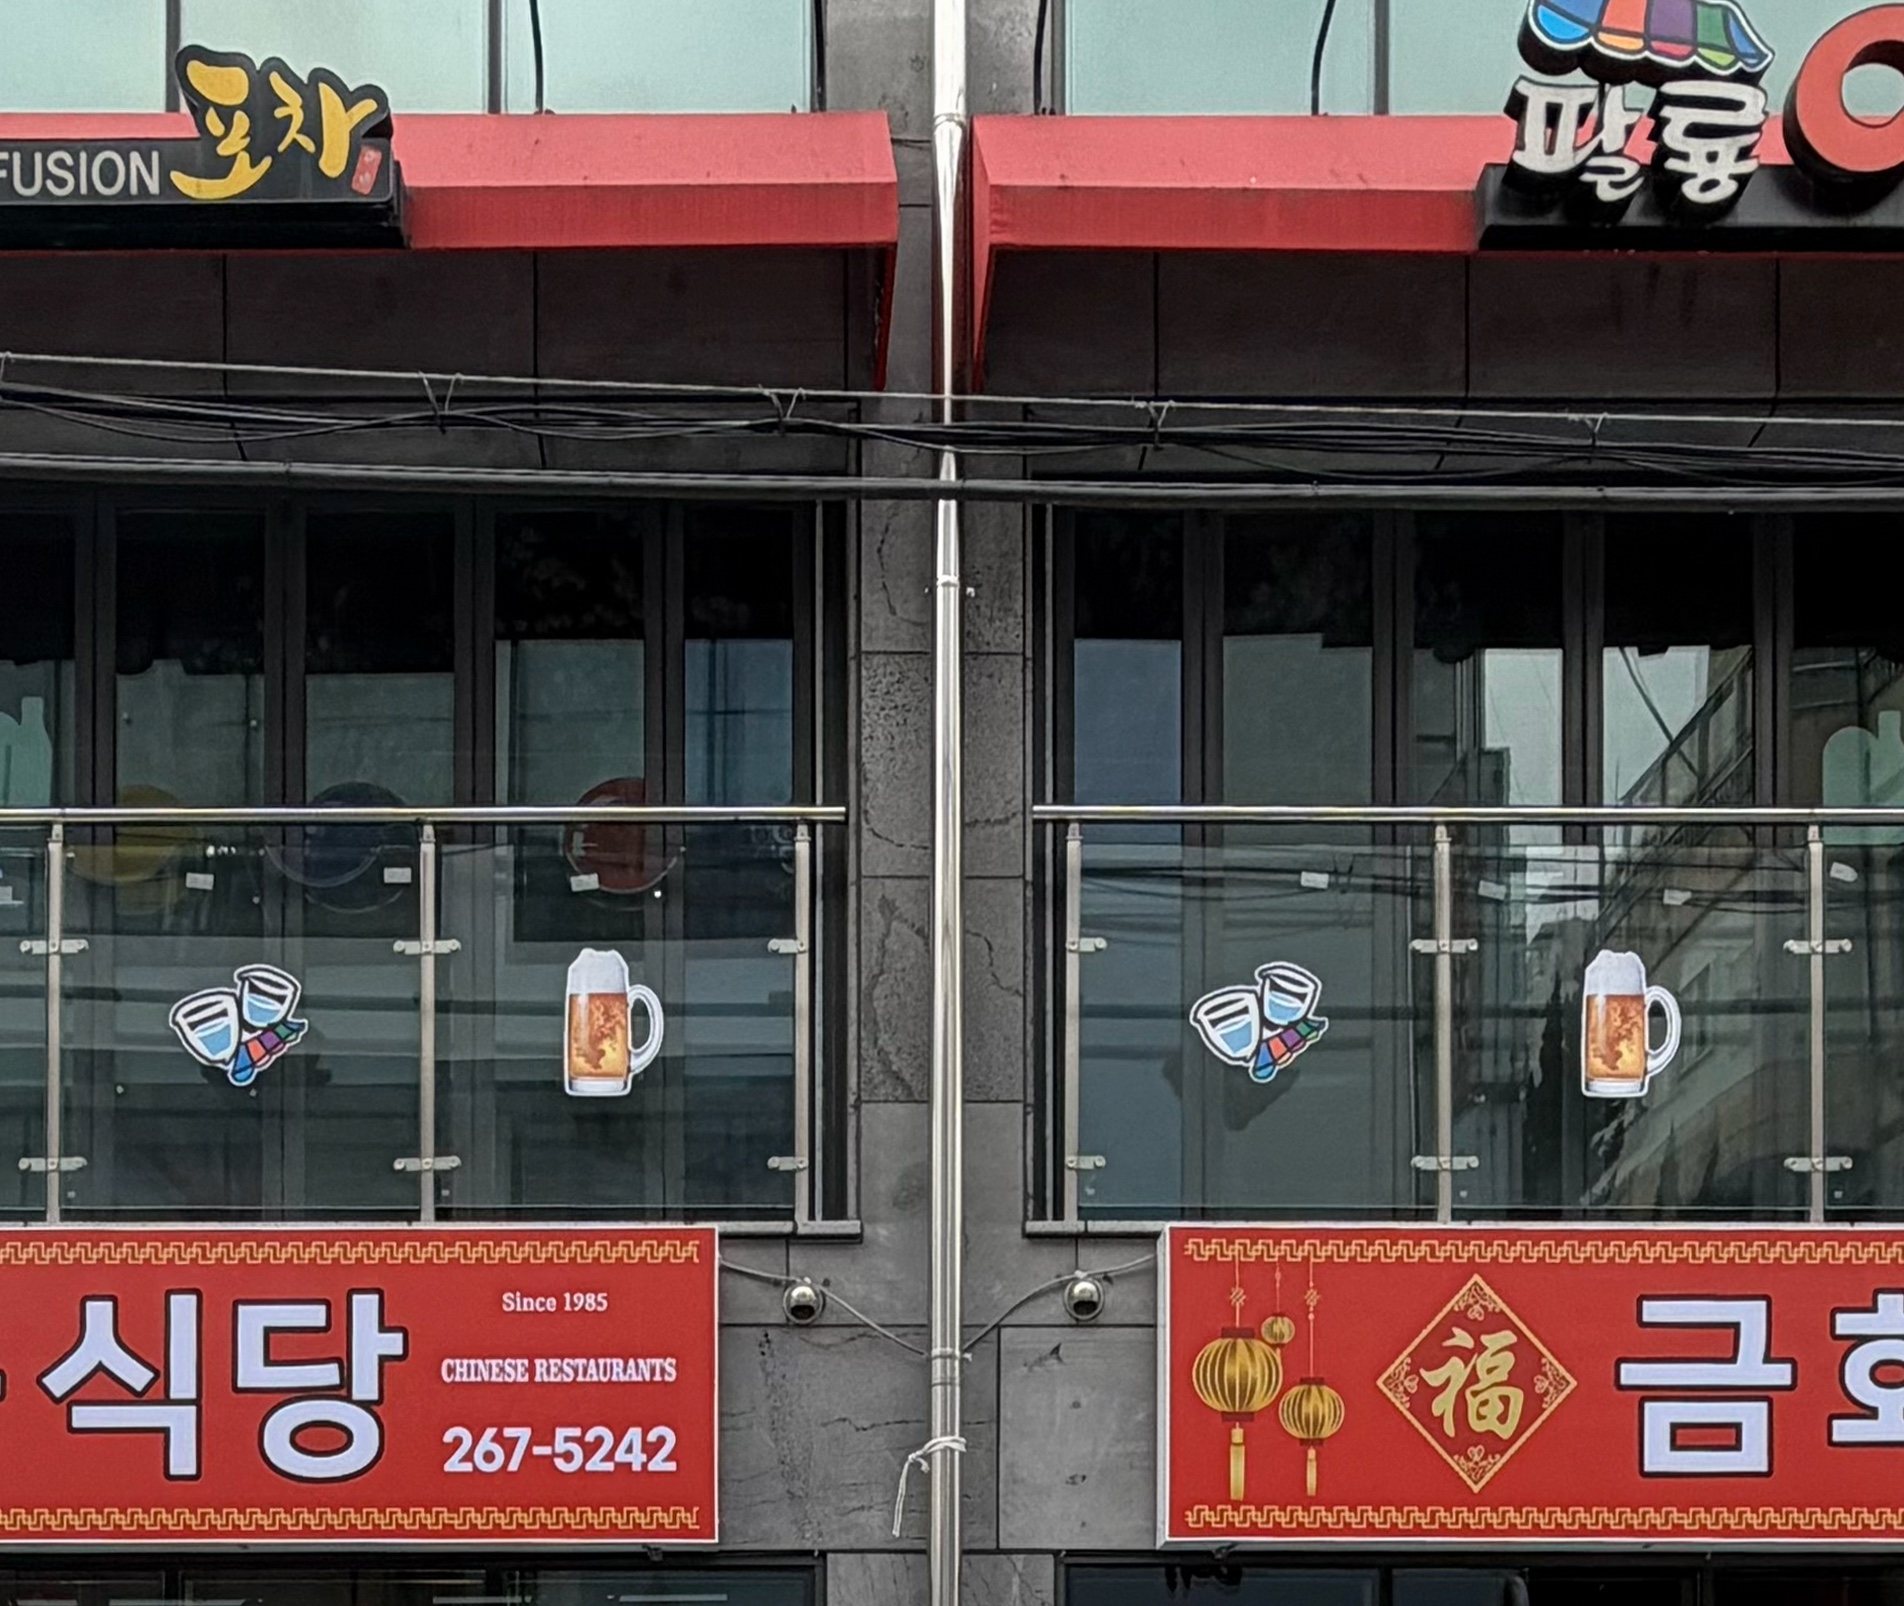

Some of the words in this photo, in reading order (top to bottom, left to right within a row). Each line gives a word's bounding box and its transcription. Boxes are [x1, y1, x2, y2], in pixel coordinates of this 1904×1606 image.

[169, 59, 379, 200] 포차
[1512, 76, 1768, 204] 팔룡
[502, 1291, 557, 1312] Since
[563, 1291, 609, 1312] 1985
[441, 1357, 529, 1383] CHINESE
[534, 1356, 678, 1383] RESTAURANTS
[1420, 1326, 1526, 1441] 福
[442, 1425, 678, 1474] 267-5242
